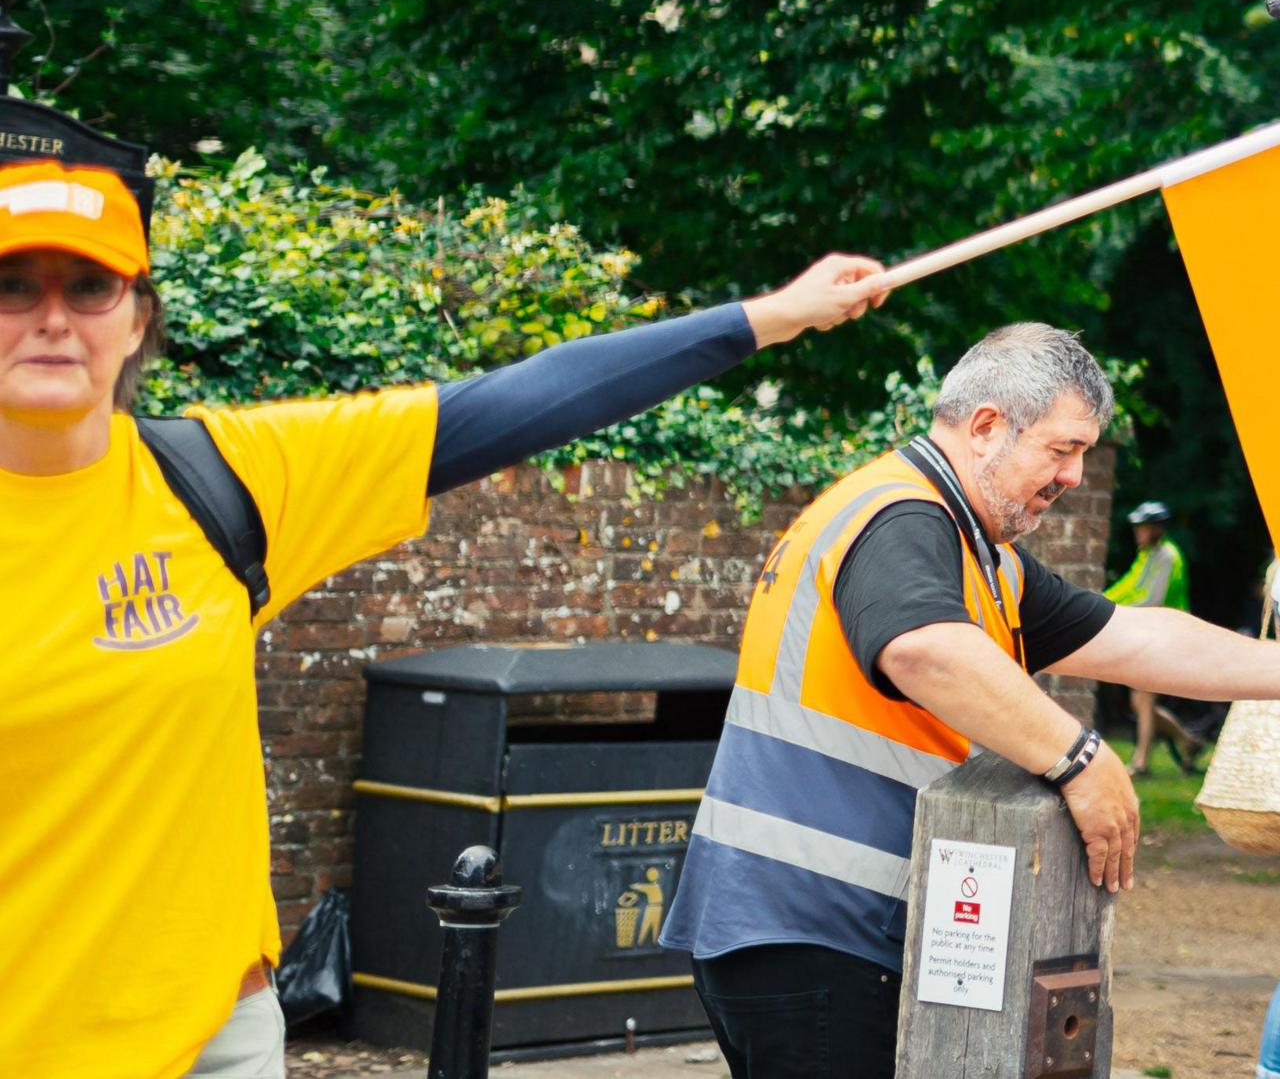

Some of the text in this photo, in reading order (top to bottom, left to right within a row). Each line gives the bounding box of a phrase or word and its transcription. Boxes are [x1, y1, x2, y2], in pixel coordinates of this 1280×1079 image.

[97, 551, 172, 601] HAT
[104, 593, 184, 639] FAIR
[601, 820, 688, 848] LITTER
[962, 904, 972, 913] No
[955, 912, 979, 922] parking
[932, 927, 996, 942] No parking for the
[931, 938, 995, 953] public at any time
[929, 954, 996, 971] Permit holders and
[928, 967, 994, 985] authorised parking
[953, 984, 969, 996] only
